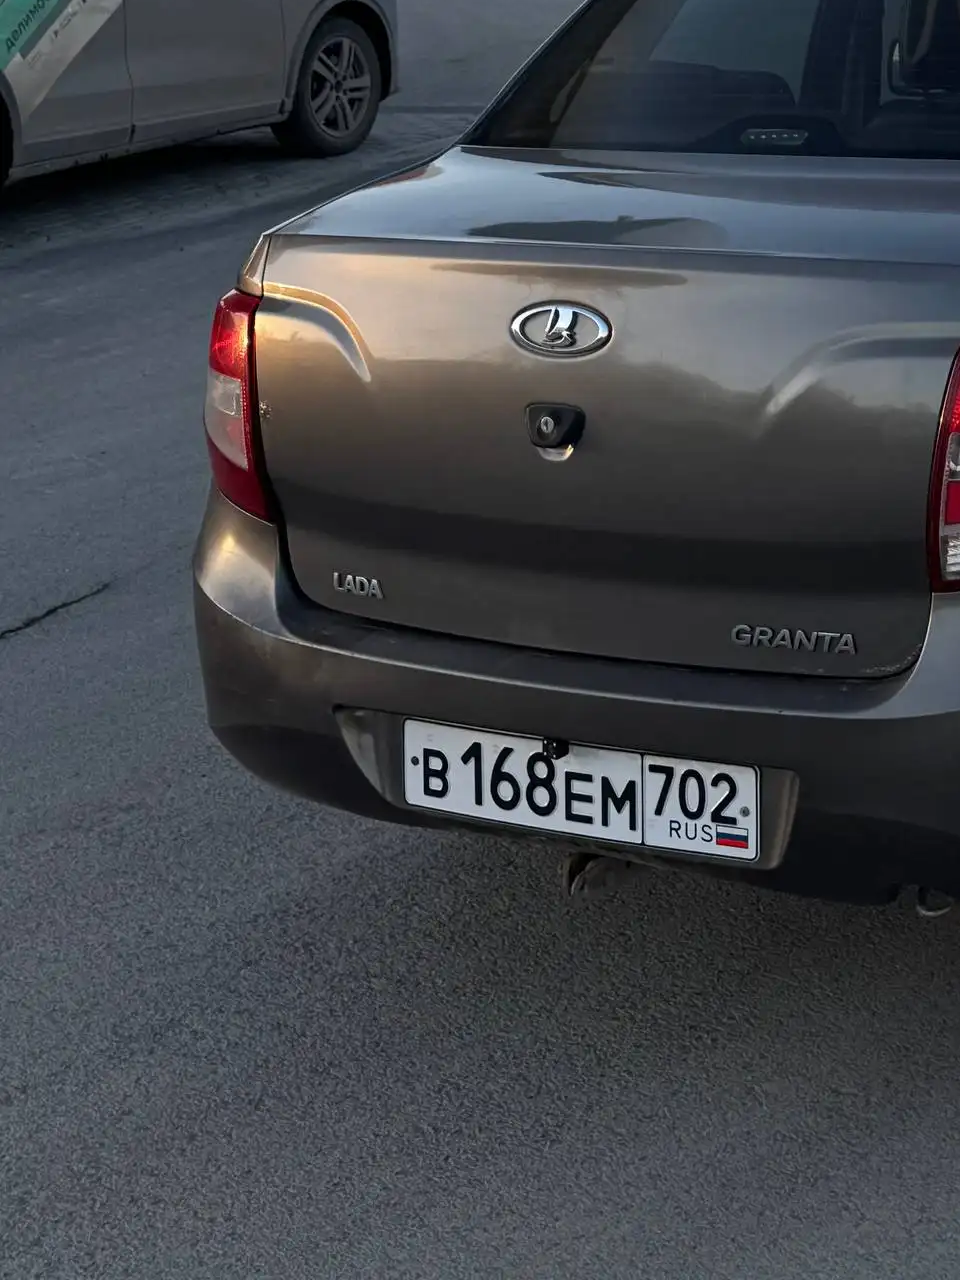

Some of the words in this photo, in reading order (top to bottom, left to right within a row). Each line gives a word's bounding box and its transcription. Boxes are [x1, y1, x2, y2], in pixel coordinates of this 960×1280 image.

[333, 571, 384, 600] LADA
[730, 624, 857, 656] GRANTA
[647, 763, 739, 826] 702
[669, 819, 714, 843] RUS
